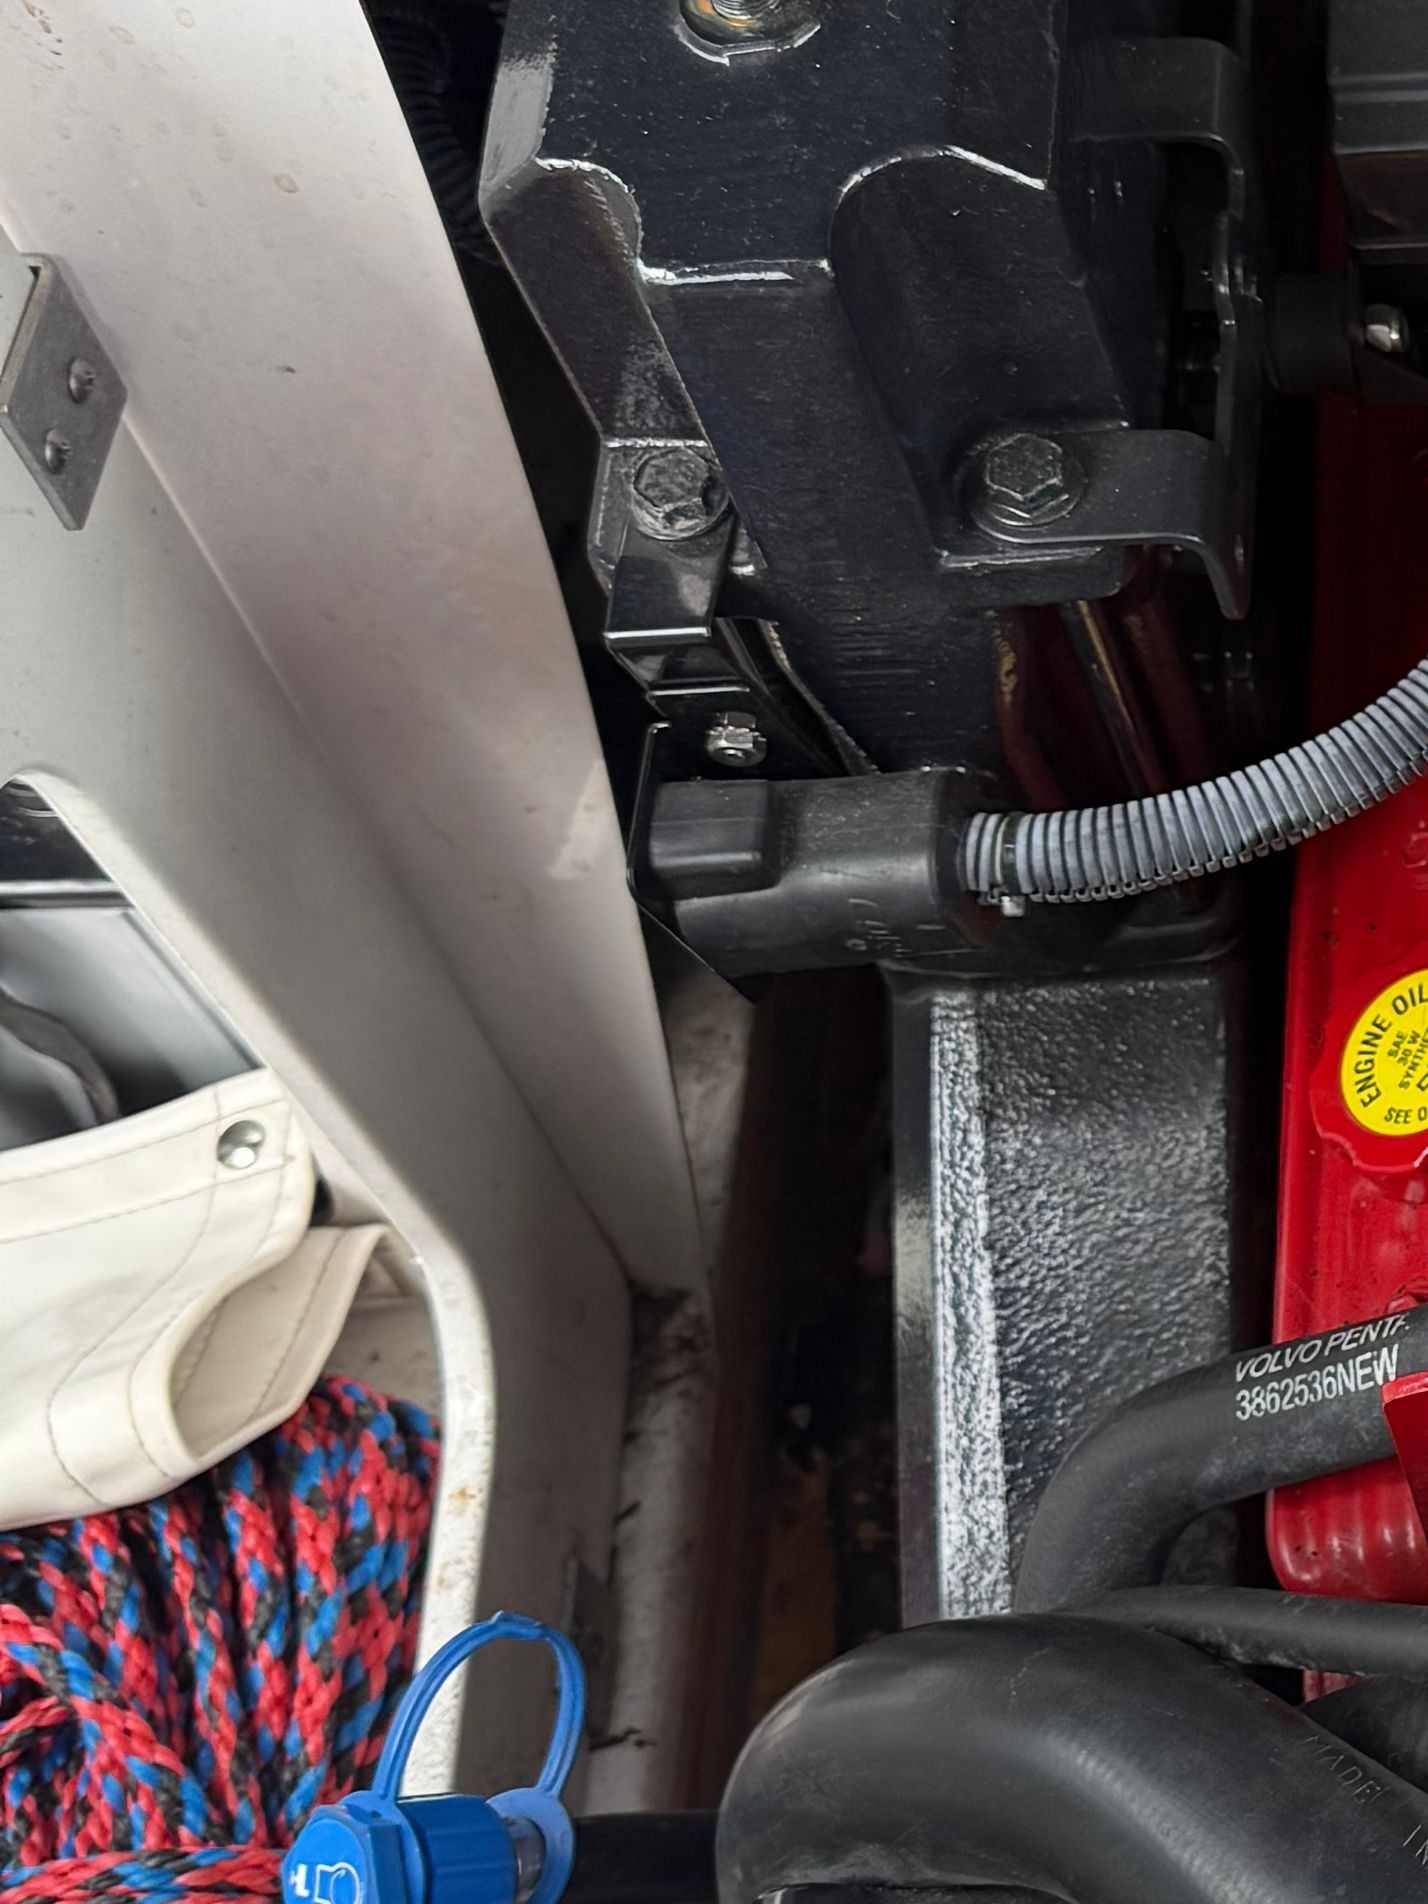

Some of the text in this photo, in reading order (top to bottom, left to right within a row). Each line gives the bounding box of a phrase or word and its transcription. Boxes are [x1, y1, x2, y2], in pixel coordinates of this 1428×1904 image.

[1354, 1014, 1393, 1108] ENGINE
[1387, 1031, 1407, 1058] SAE
[1397, 1030, 1421, 1066] 30 W
[1384, 1107, 1413, 1124] SEE
[1235, 1339, 1322, 1383] VOLVO
